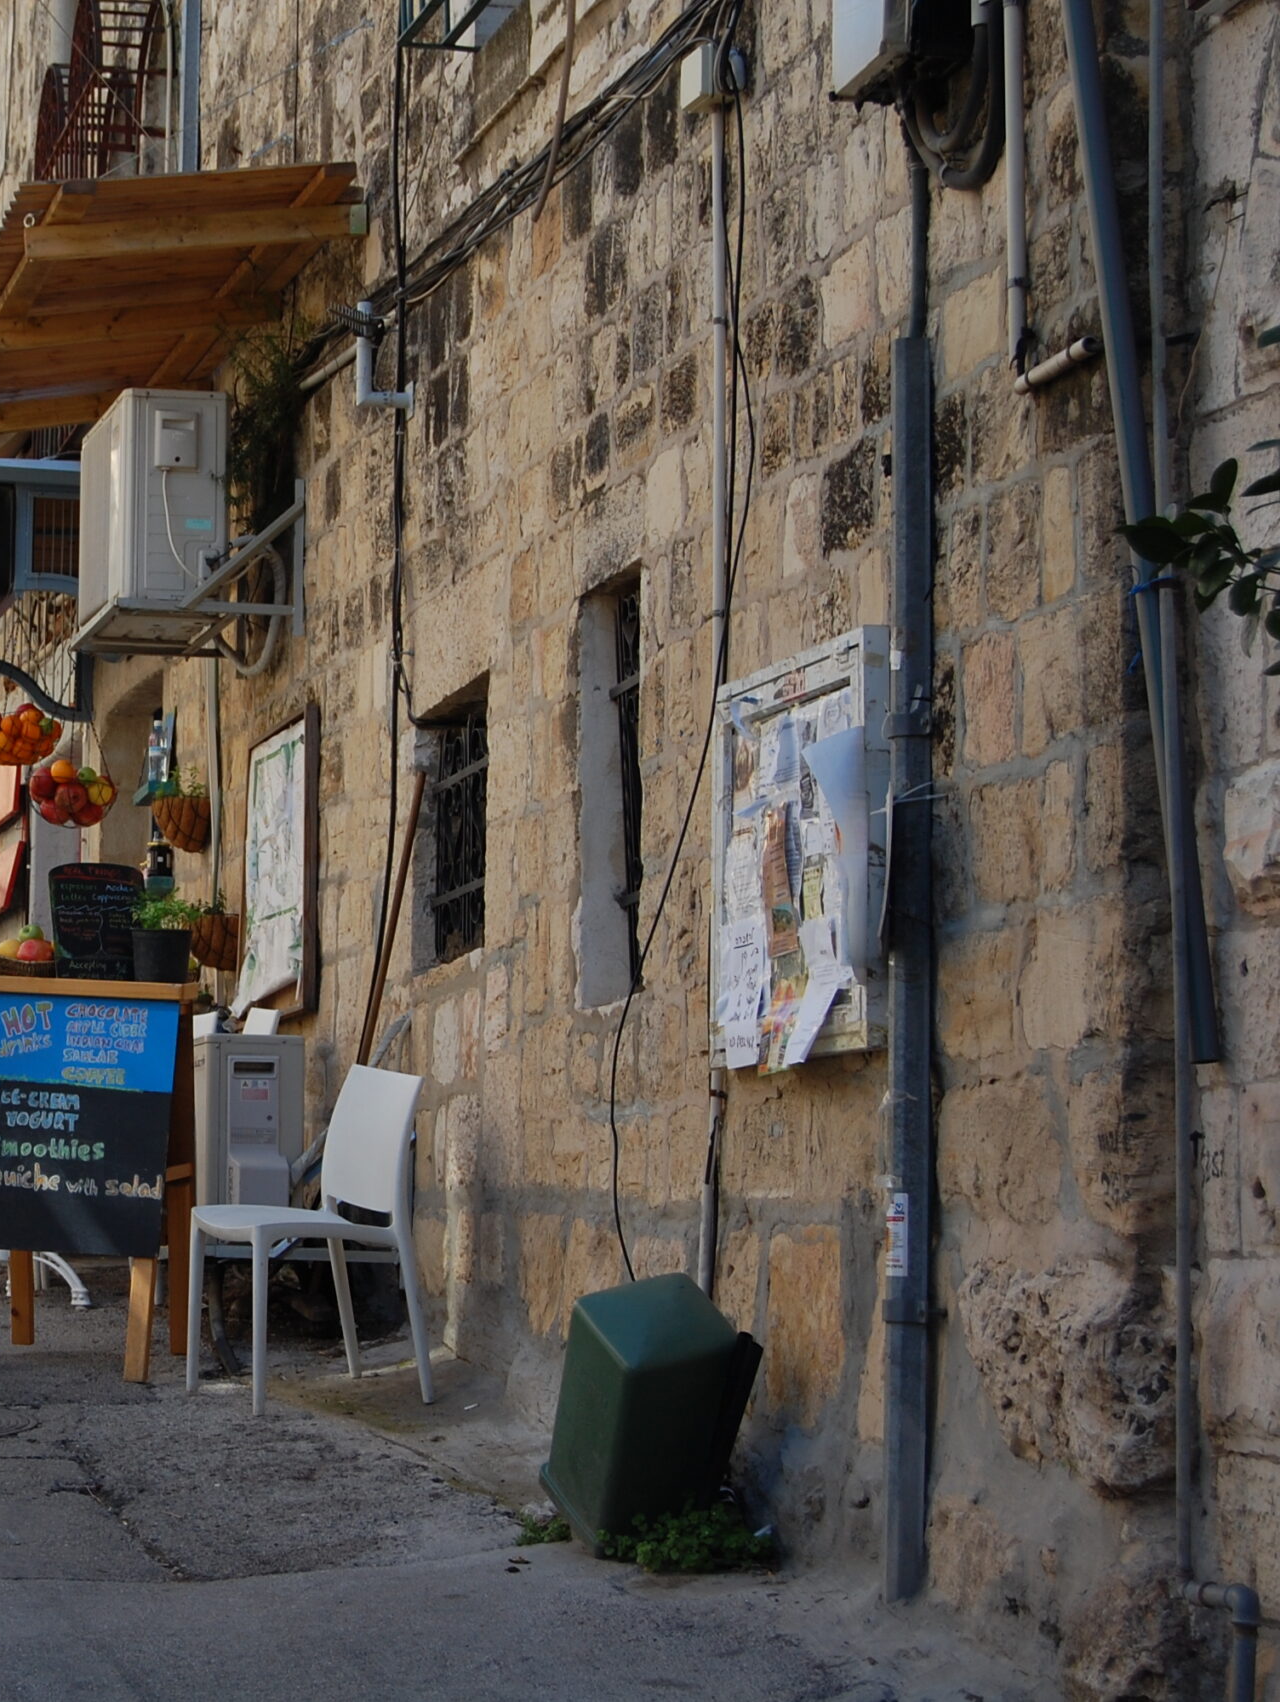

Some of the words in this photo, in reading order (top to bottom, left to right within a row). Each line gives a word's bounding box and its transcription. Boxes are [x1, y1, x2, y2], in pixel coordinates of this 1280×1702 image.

[1, 1001, 53, 1038] HOT
[65, 1003, 148, 1024] CHOCOLATE
[109, 1022, 147, 1038] CIDER
[65, 1032, 113, 1048] INDIAN
[61, 1067, 126, 1085] COFFEE
[6, 1110, 79, 1132] YOGURT
[65, 1178, 98, 1196] with
